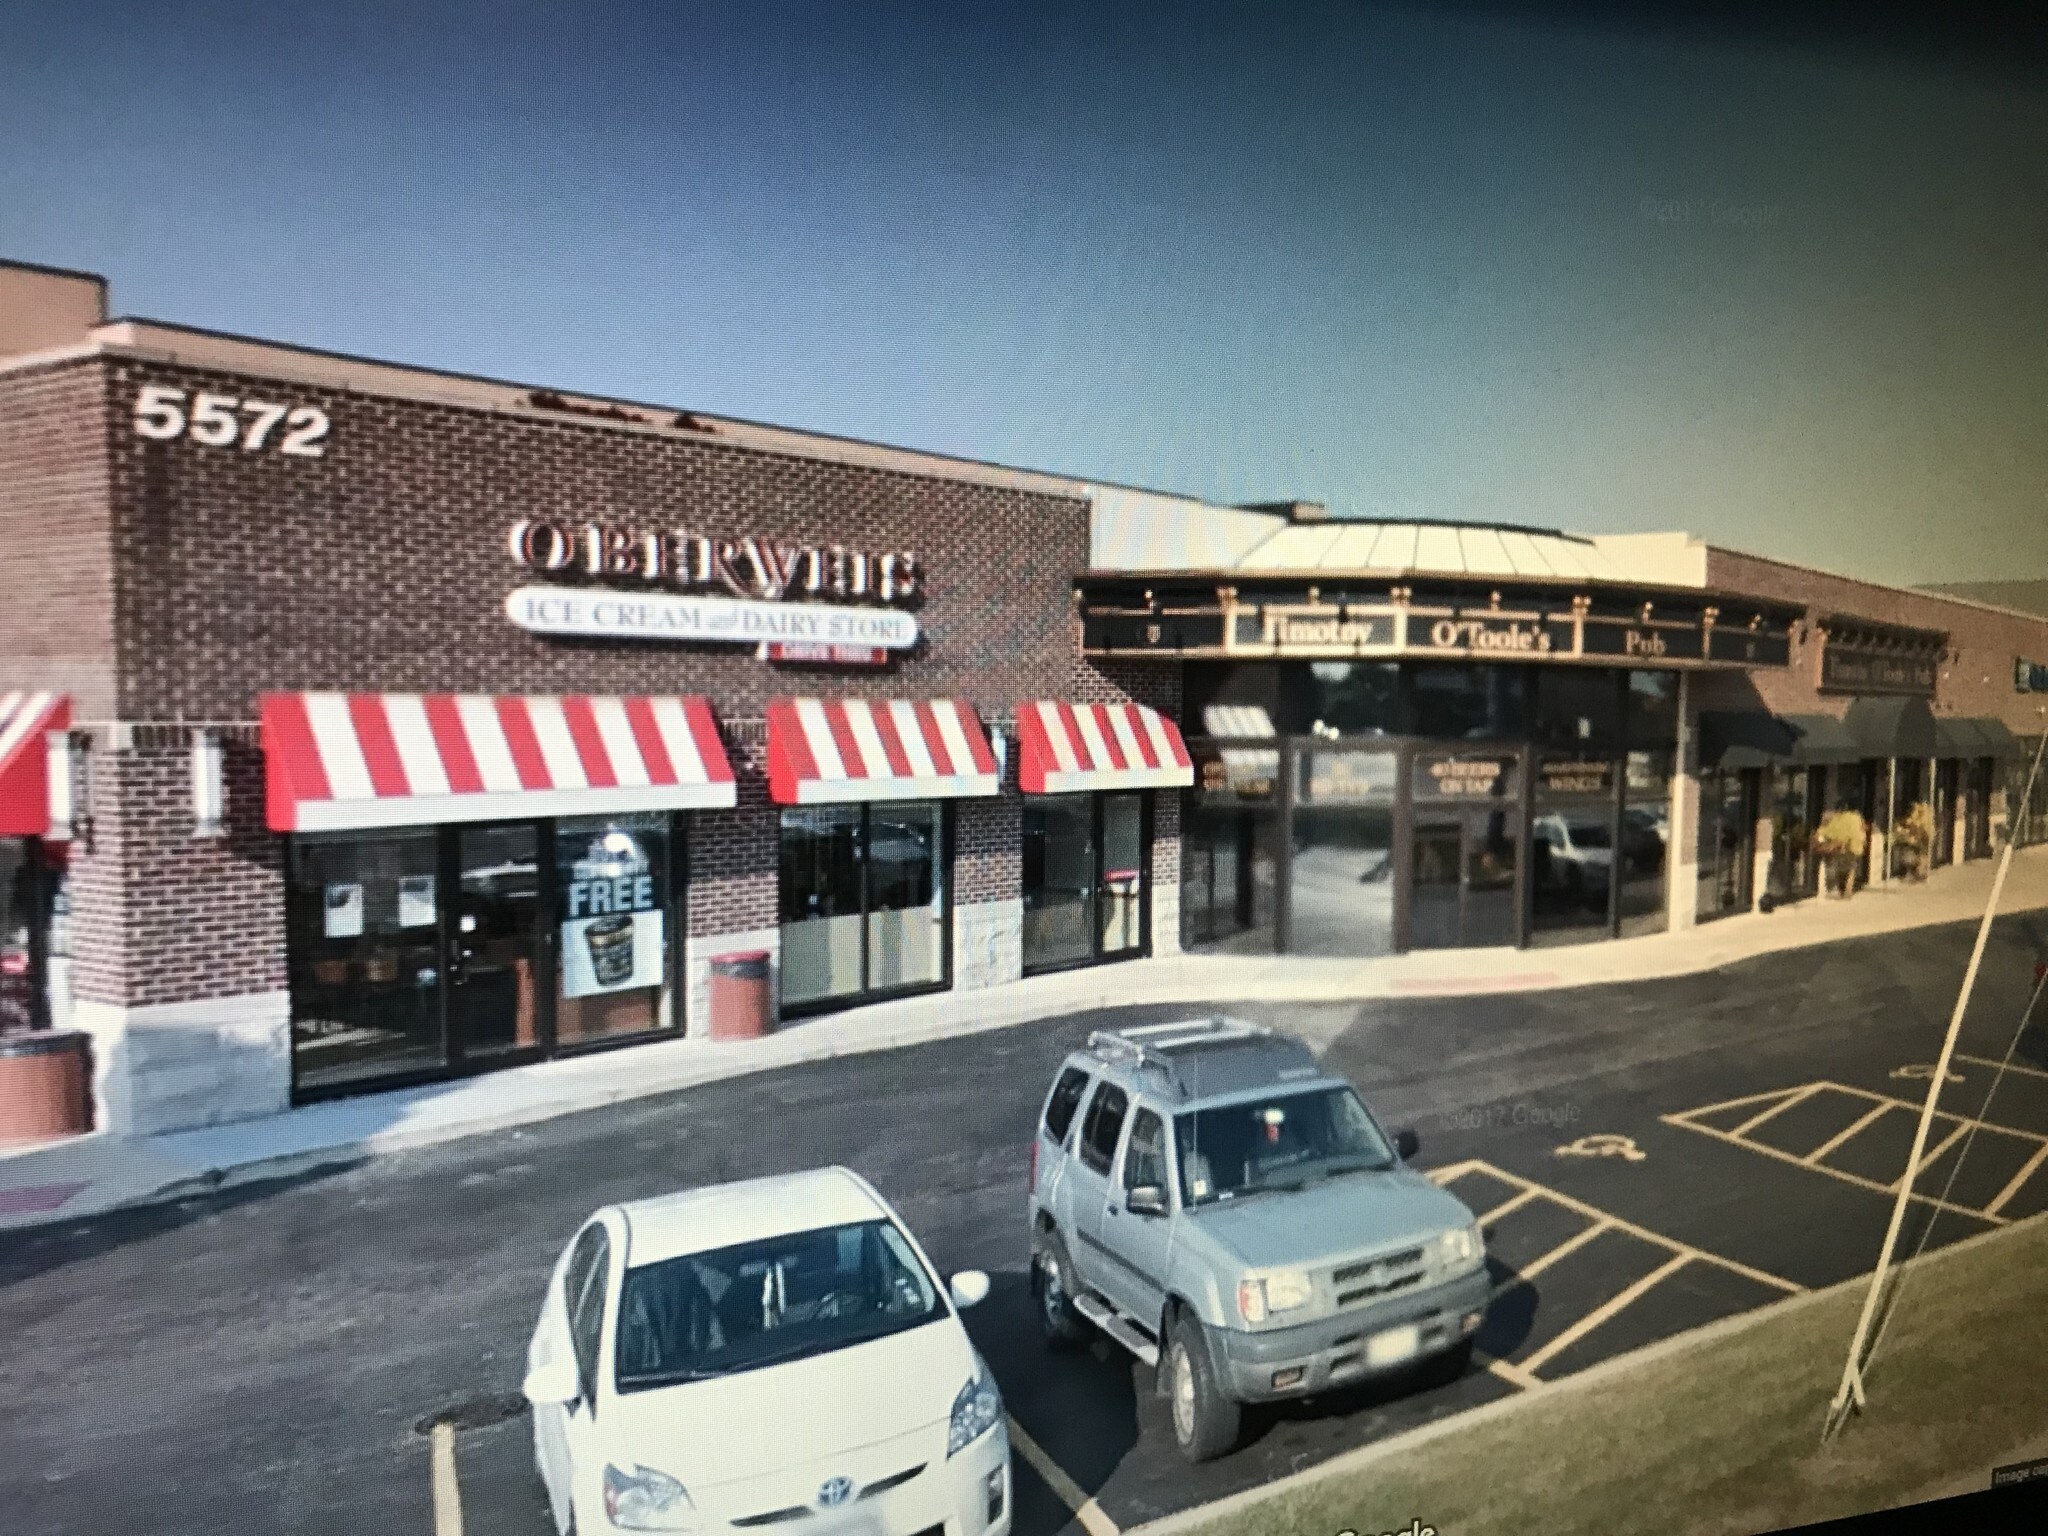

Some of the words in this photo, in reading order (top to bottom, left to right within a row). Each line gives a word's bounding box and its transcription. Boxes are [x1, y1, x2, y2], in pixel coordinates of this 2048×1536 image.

[133, 385, 331, 458] 5572
[526, 599, 583, 625] ICE
[593, 601, 700, 631] CREAM
[743, 607, 819, 636] DAIRY
[828, 612, 907, 641] STORE
[1431, 619, 1551, 651] O'Toole's
[1625, 629, 1667, 656] Pub
[568, 875, 654, 916] FREE
